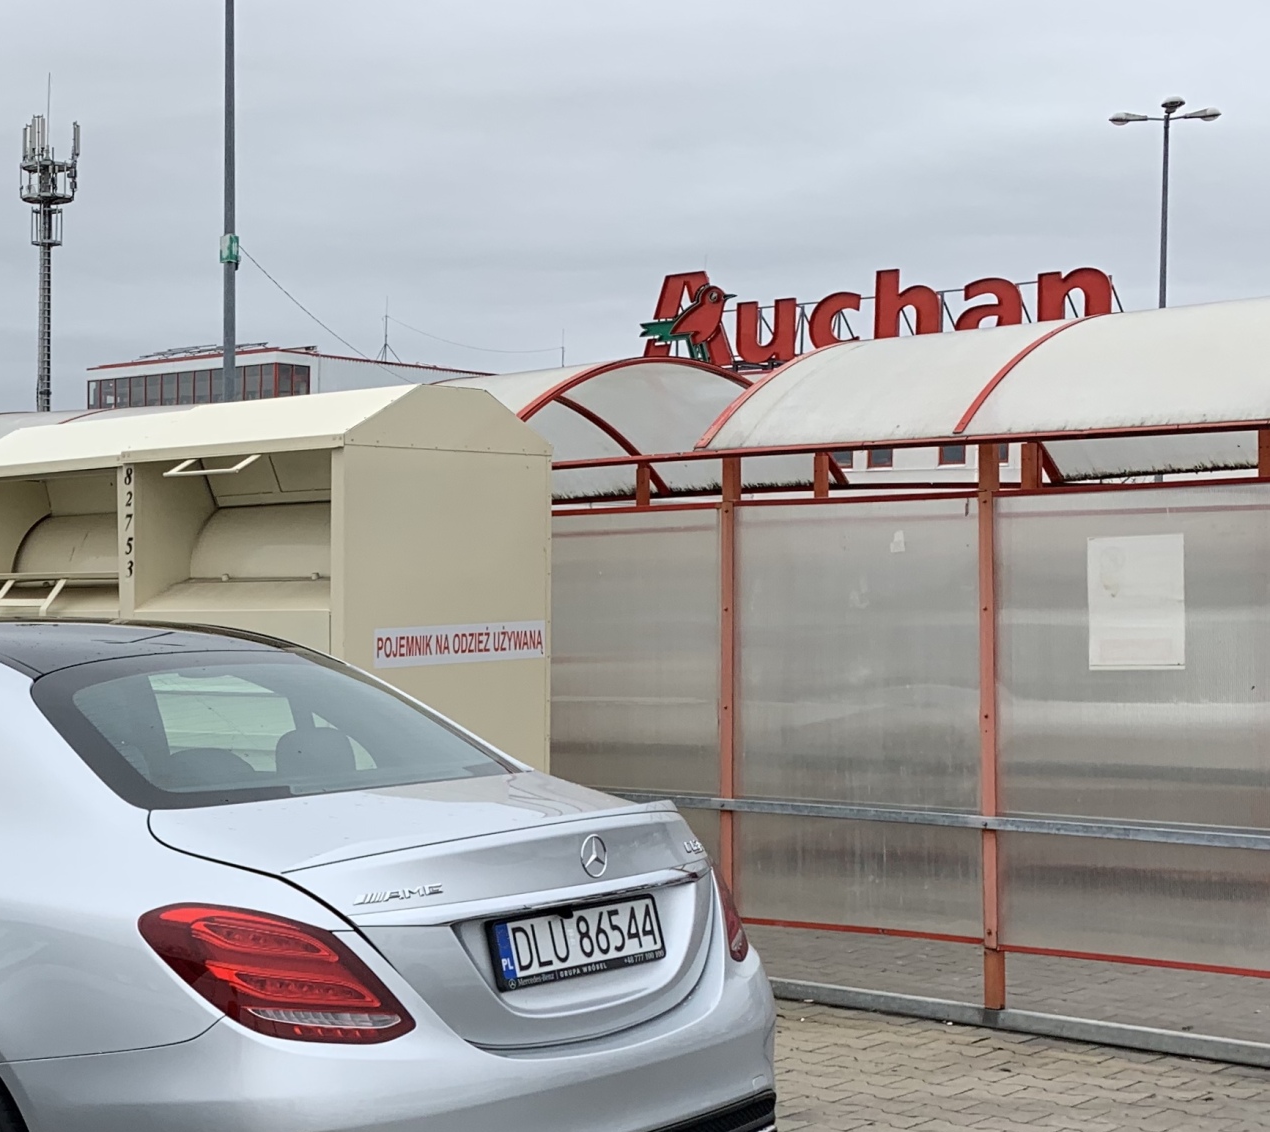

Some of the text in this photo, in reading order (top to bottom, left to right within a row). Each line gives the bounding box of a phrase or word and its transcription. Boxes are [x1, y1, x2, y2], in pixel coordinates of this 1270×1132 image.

[643, 267, 1113, 367] Auchan
[124, 468, 134, 578] 82753
[376, 625, 544, 659] POJEMNIK NA ODZIEŻ UŻYWANĄ
[511, 903, 658, 972] DLU 86544
[501, 957, 515, 972] PL
[517, 971, 556, 986] Mercedes-Benz
[559, 968, 581, 979] GRUPA
